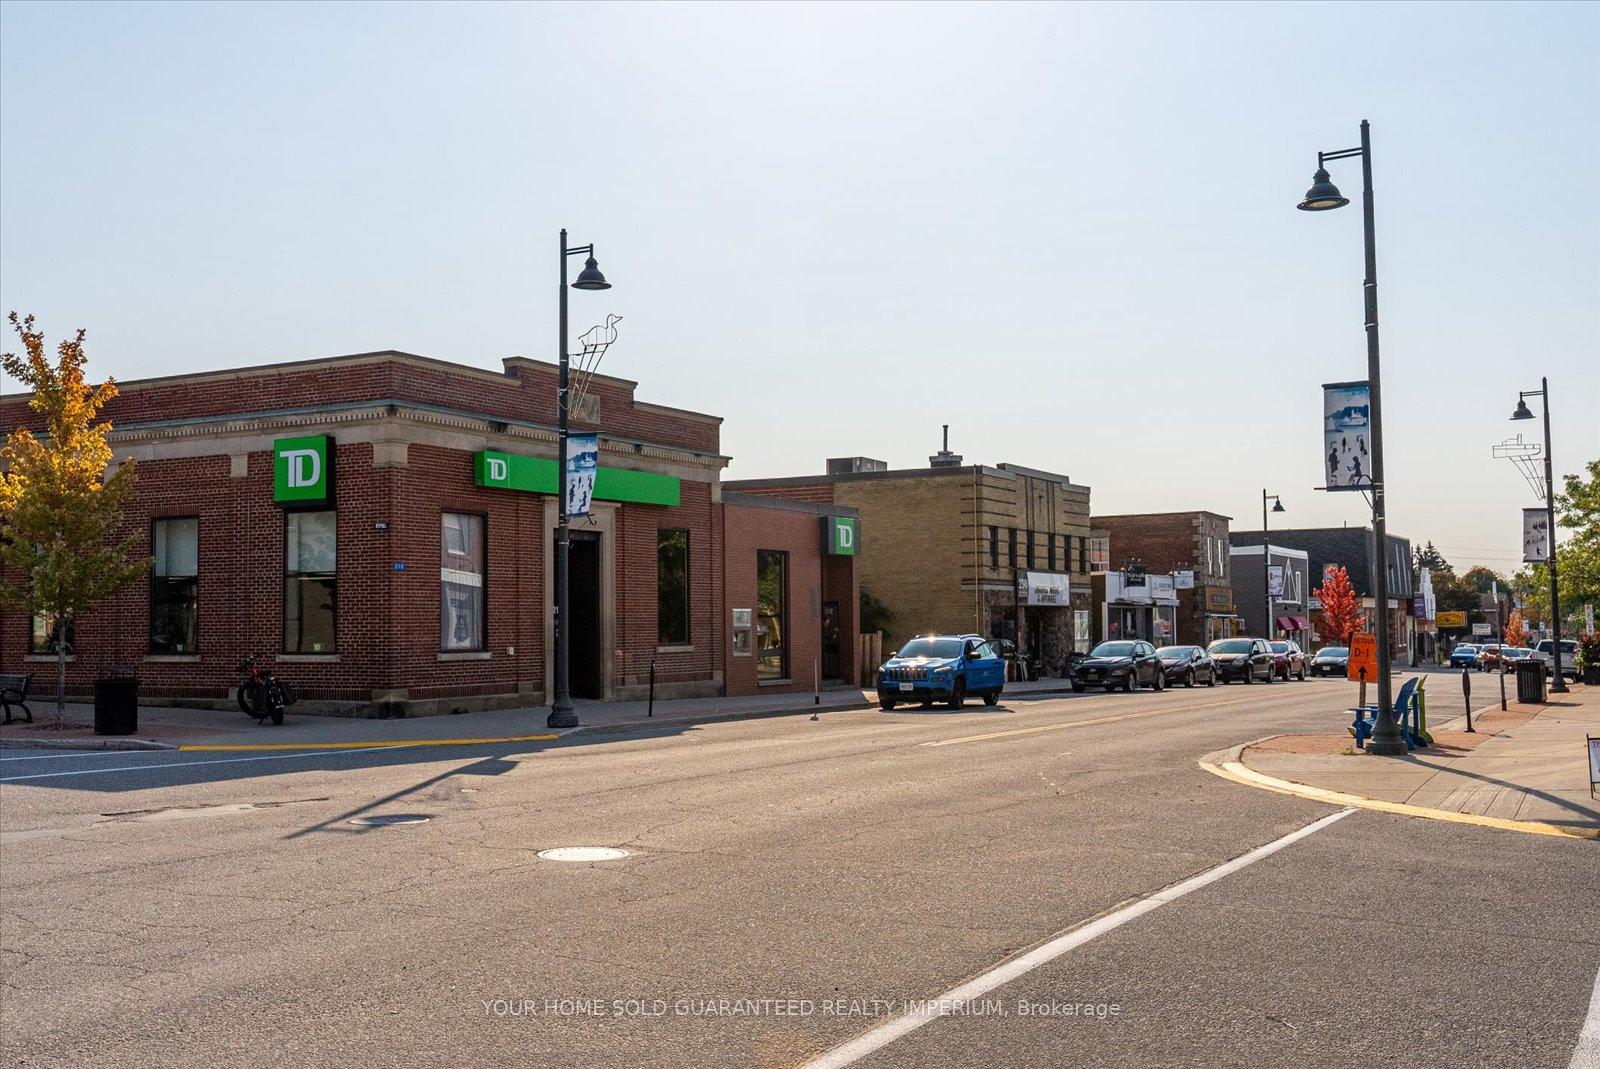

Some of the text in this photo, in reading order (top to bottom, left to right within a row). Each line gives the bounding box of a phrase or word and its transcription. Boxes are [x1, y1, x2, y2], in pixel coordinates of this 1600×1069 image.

[280, 449, 321, 488] TD
[487, 458, 507, 480] TD
[836, 524, 853, 547] TD
[1353, 637, 1375, 645] DETOUR
